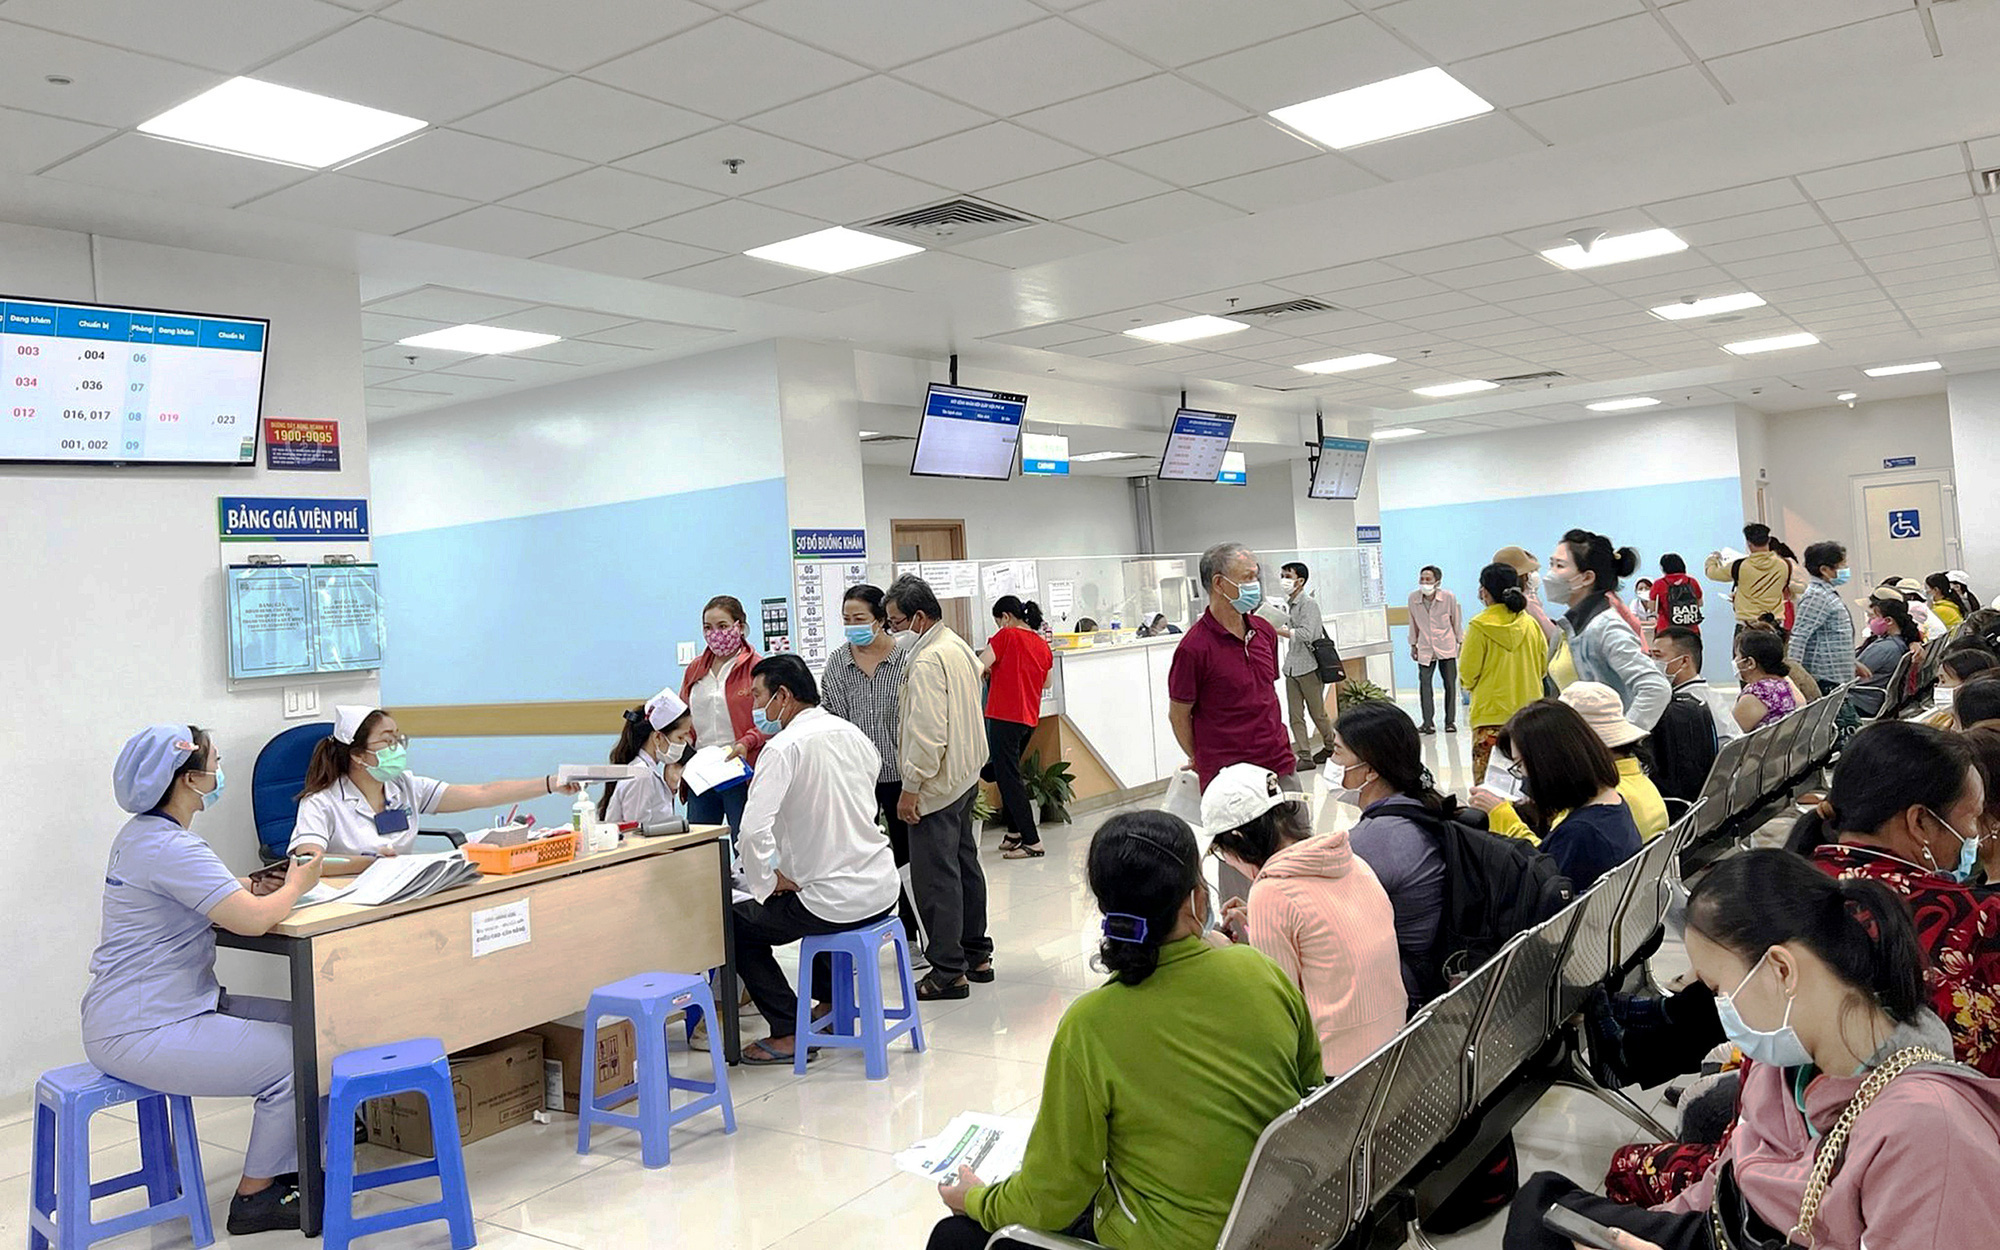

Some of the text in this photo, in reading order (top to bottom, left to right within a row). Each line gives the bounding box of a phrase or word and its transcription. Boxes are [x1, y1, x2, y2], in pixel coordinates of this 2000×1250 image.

[17, 345, 40, 356] 003
[84, 350, 105, 360] 004
[133, 353, 147, 363] 06
[15, 377, 37, 387] 034
[82, 380, 103, 390] 036
[130, 383, 145, 392] 07
[13, 408, 36, 418] 012
[90, 410, 111, 420] 017
[128, 412, 142, 421] 08
[159, 413, 179, 423] 019
[217, 415, 236, 425] 023
[274, 429, 333, 443] 1900-9095
[87, 440, 108, 450] 002
[125, 441, 140, 451] 09
[228, 504, 358, 534] BẢNG GIÁ VIỆN PHÍ
[843, 534, 864, 550] KHÁM
[804, 565, 814, 574] 05
[851, 565, 860, 574] 06
[805, 586, 815, 595] 04
[806, 607, 816, 616] 03
[1673, 604, 1698, 615] BAD
[808, 627, 817, 636] 02
[809, 648, 818, 657] 01
